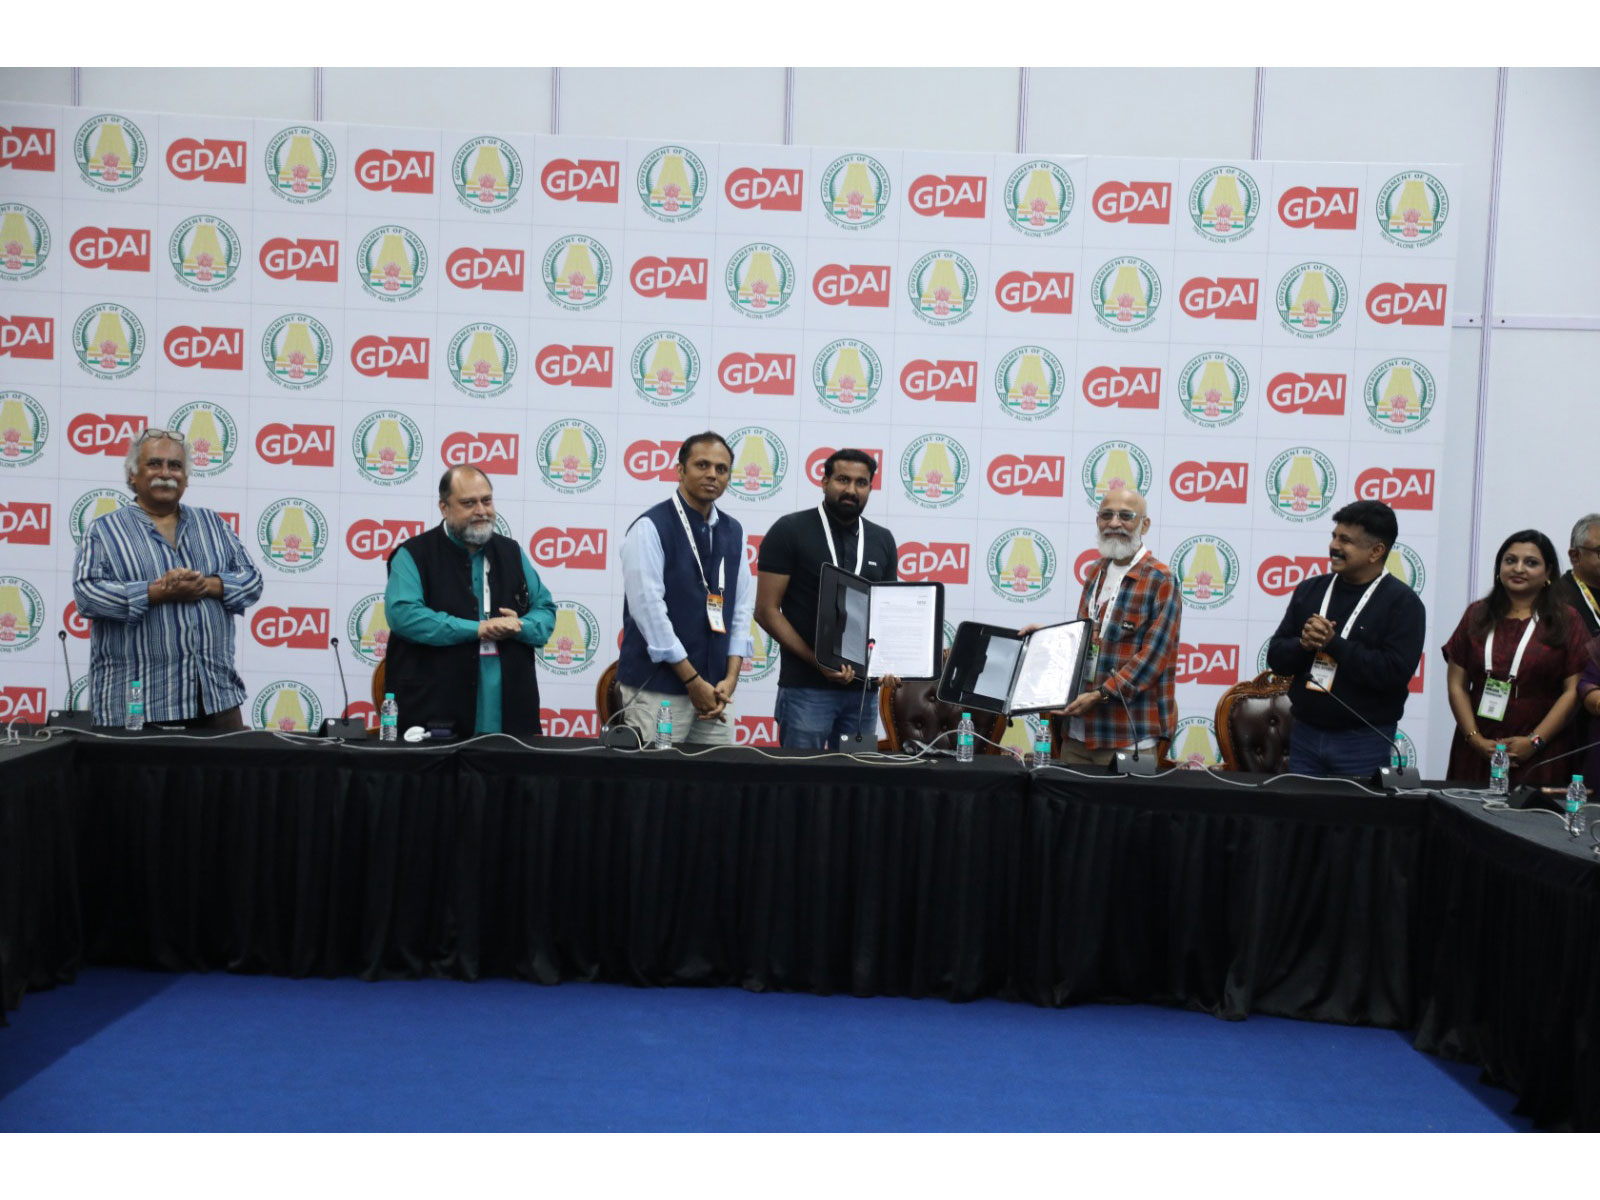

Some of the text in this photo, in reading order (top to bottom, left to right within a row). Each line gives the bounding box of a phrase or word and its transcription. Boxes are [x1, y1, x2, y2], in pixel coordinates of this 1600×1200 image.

[2, 133, 52, 159] DAI
[172, 145, 243, 173] GDAI
[360, 155, 430, 183] GDAI
[546, 165, 616, 193] GDAI
[730, 173, 800, 202] GDAI
[914, 180, 983, 209] GDAI
[1098, 186, 1168, 215] GDAI
[1283, 192, 1355, 221] GDAI
[75, 233, 147, 261] GDAI
[265, 244, 335, 272] GDAI
[451, 254, 521, 281] GDAI
[635, 262, 704, 290] GDAI
[818, 270, 887, 298] GDAI
[1001, 276, 1070, 305] GDAI
[1185, 282, 1255, 311] GDAI
[1371, 288, 1443, 317] GDAI
[1, 321, 50, 347] DAI
[169, 332, 240, 360] GDAI
[356, 342, 426, 369] GDAI
[541, 350, 610, 378] GDAI
[723, 358, 792, 386] GDAI
[905, 365, 974, 393] GDAI
[1088, 372, 1157, 400] GDAI
[1272, 378, 1343, 406] GDAI
[261, 429, 331, 457] GDAI
[446, 438, 515, 465] GDAI
[629, 447, 680, 474] GDA
[992, 460, 1061, 488] GDAI
[1175, 467, 1245, 494] GDAI
[1360, 473, 1430, 501] GDAI
[0, 504, 48, 531] DAI
[535, 533, 603, 561] GDAI
[898, 547, 966, 576] GDAI
[256, 612, 326, 641] GDAI
[0, 691, 42, 717] DAI
[735, 719, 777, 746] DAI
